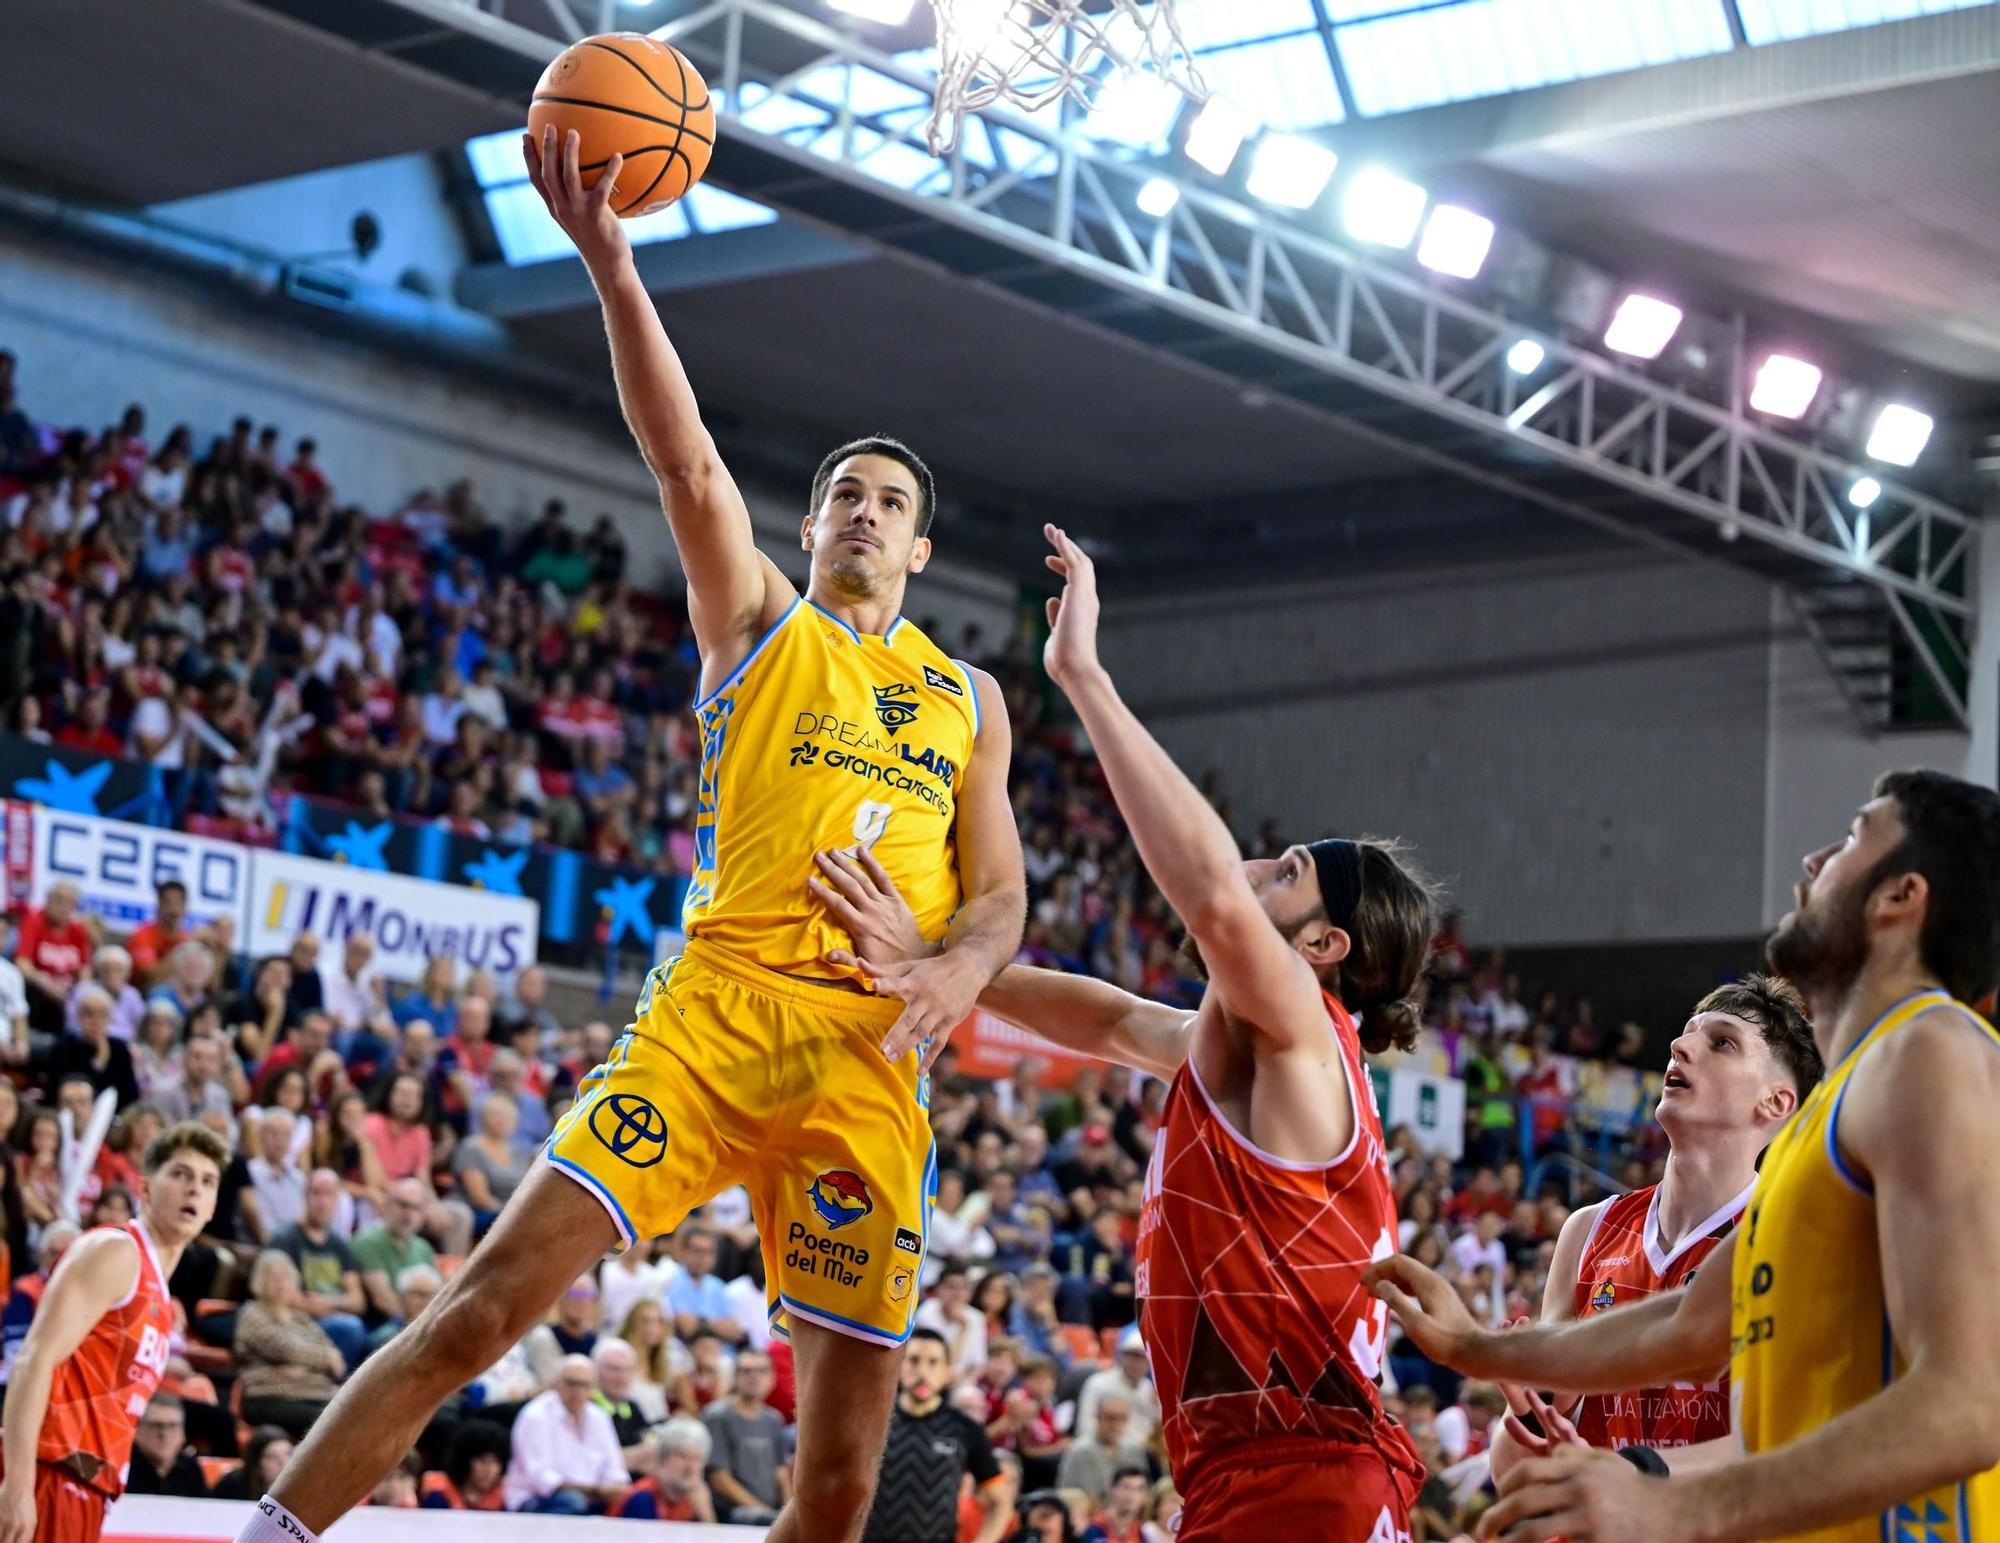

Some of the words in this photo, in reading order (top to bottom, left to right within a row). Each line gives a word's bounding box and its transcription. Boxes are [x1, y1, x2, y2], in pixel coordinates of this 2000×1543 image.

[788, 1222, 870, 1266] Poema
[897, 1237, 916, 1251] acb
[786, 1248, 816, 1275] del
[823, 1259, 864, 1289] Mar
